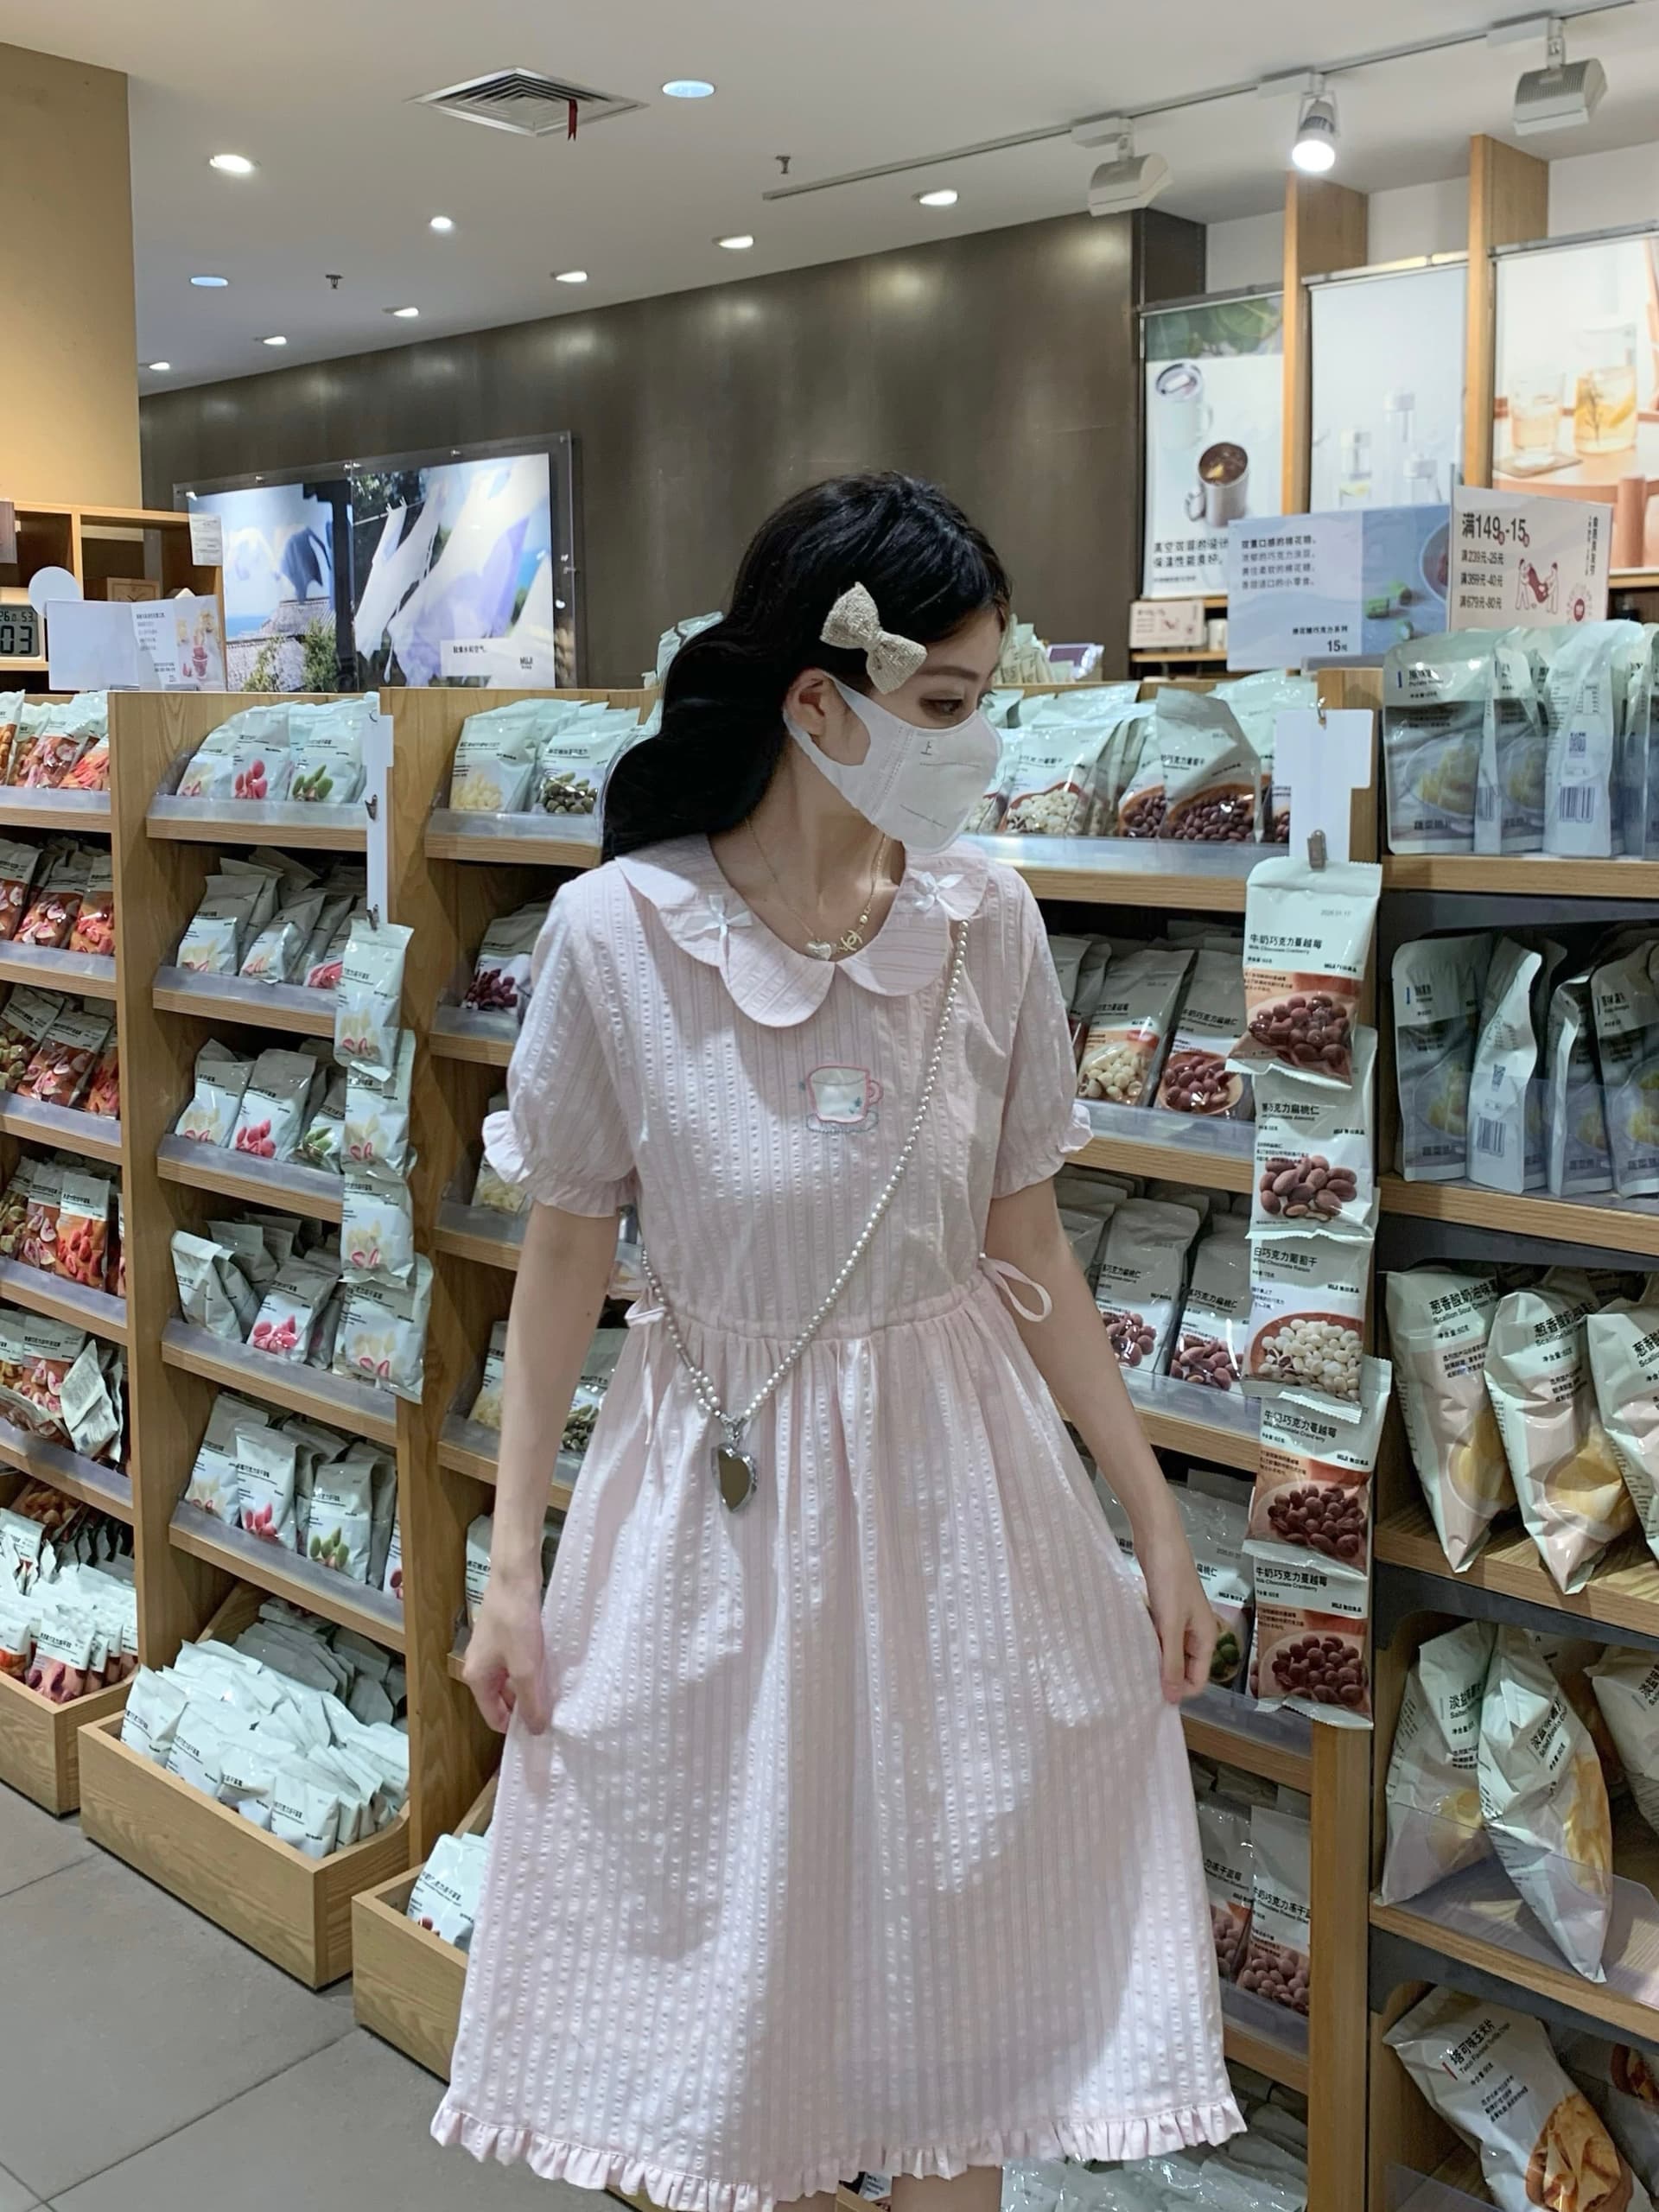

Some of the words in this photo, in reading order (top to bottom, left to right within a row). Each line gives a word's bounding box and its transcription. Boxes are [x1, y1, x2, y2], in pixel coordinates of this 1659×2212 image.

[1250, 934, 1323, 950] 牛奶巧克力蔓越莓
[1254, 1247, 1318, 1267] 白巧克力葡萄干
[1255, 1566, 1328, 1587] 牛奶巧克力蔓越莓
[1450, 2018, 1495, 2065] 塔可味玉米片
